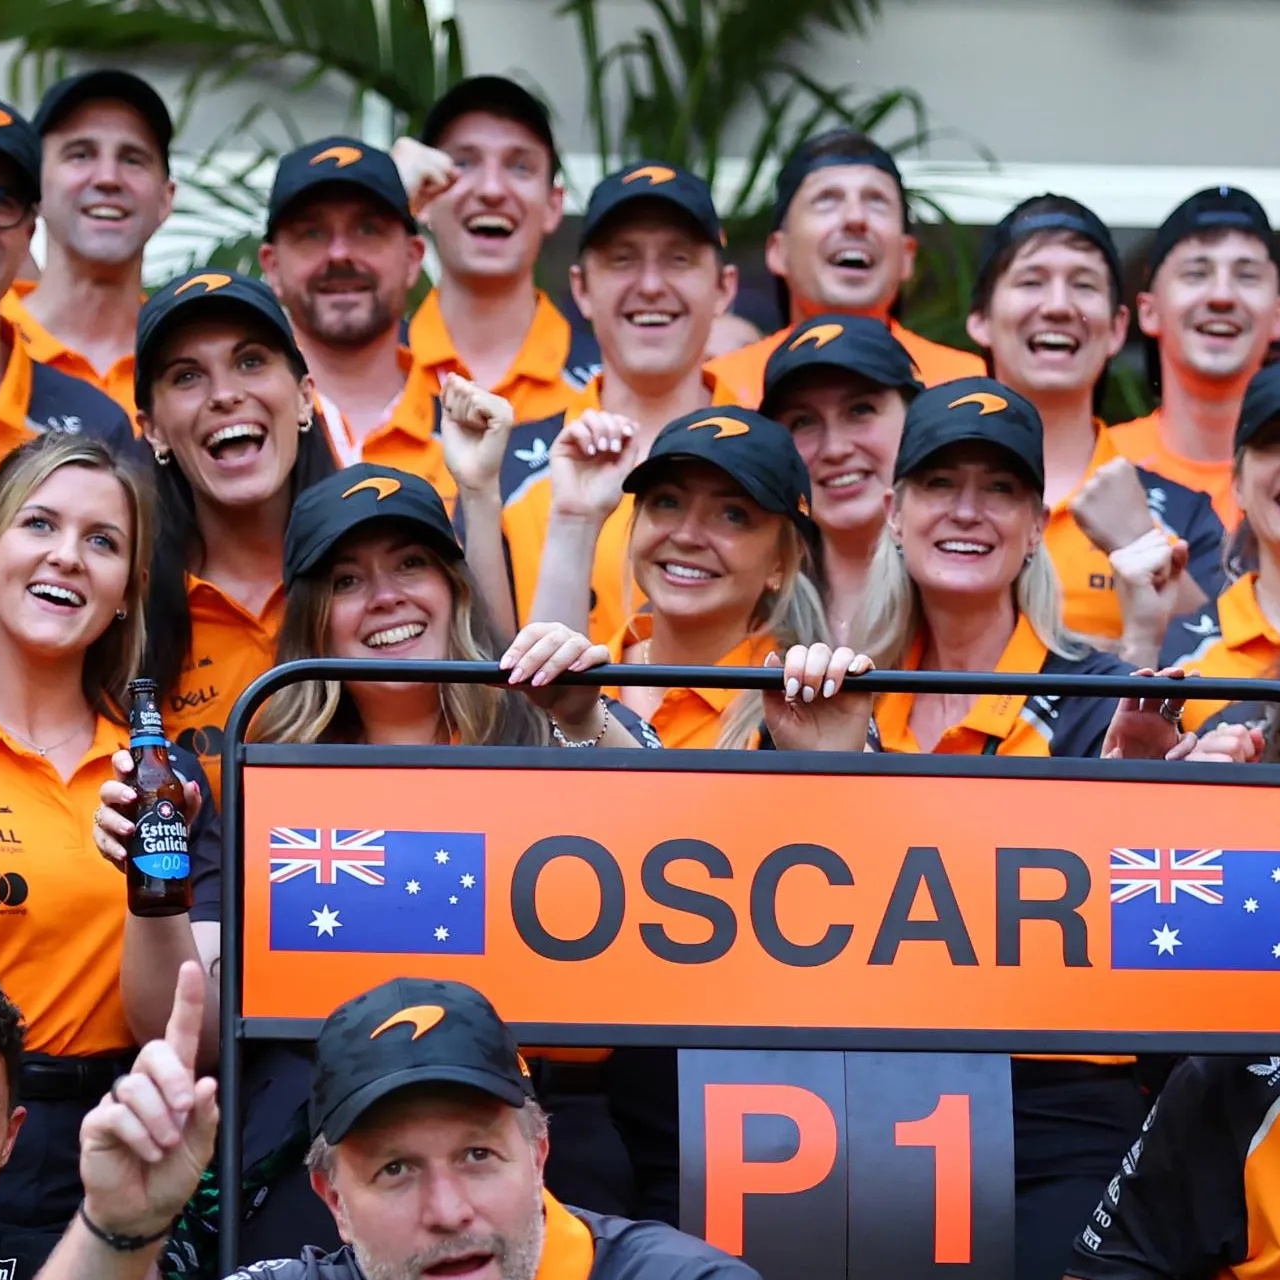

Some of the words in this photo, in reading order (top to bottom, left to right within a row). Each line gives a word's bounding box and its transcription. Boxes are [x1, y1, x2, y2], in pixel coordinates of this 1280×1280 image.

[141, 822, 188, 838] Estrella
[143, 837, 188, 853] Galicia
[511, 835, 1092, 967] OSCAR
